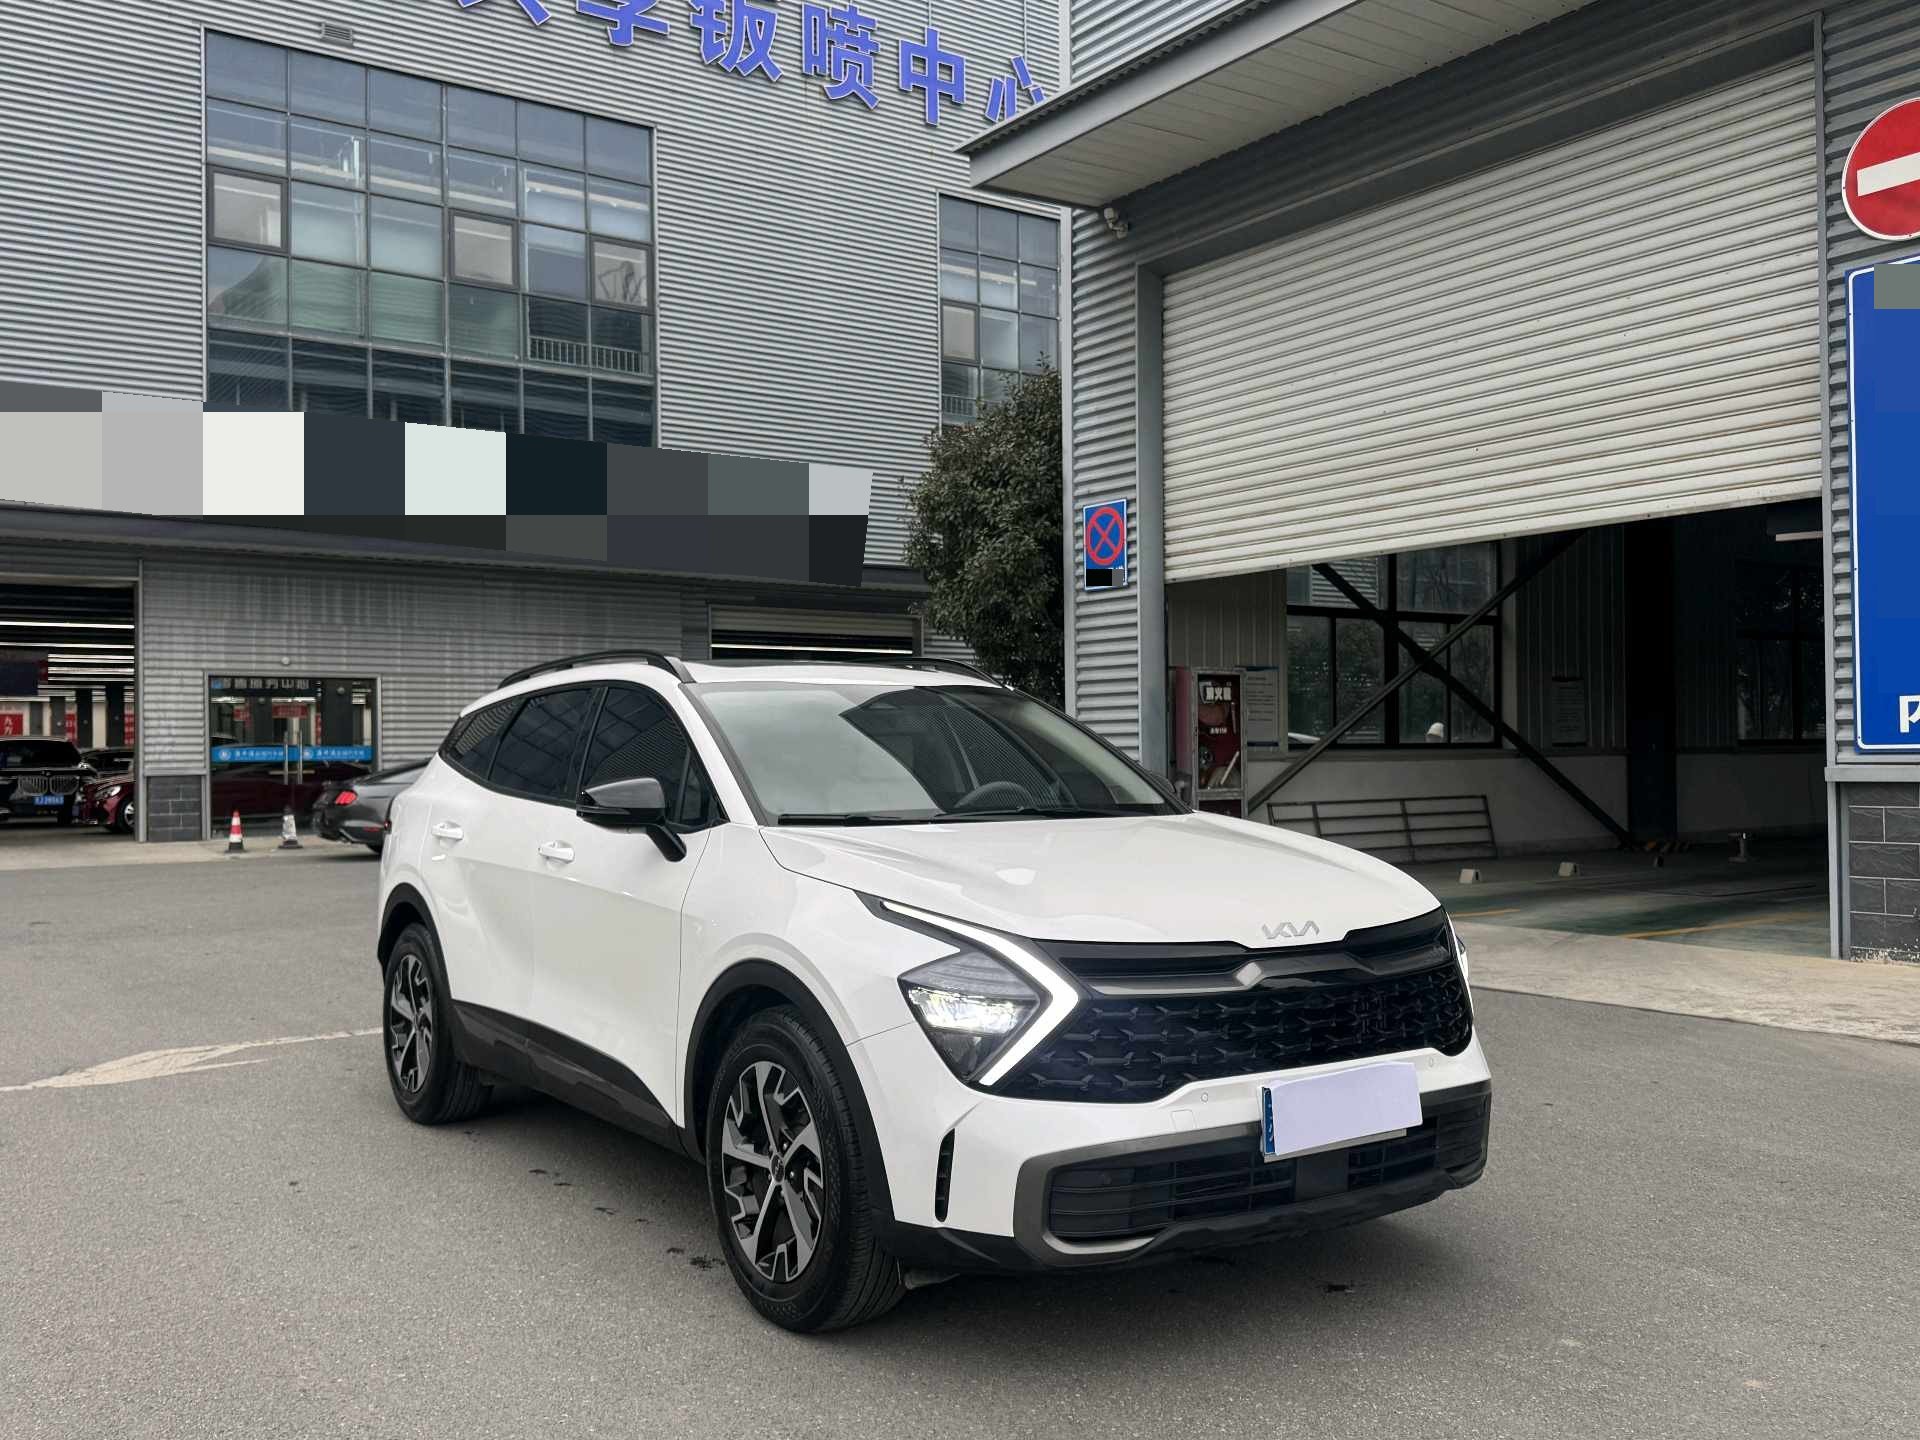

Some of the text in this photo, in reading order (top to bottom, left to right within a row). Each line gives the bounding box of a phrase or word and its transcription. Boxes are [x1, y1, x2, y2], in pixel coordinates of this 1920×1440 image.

[457, 0, 1046, 125] 钣喷中心
[1262, 920, 1320, 939] KIA
